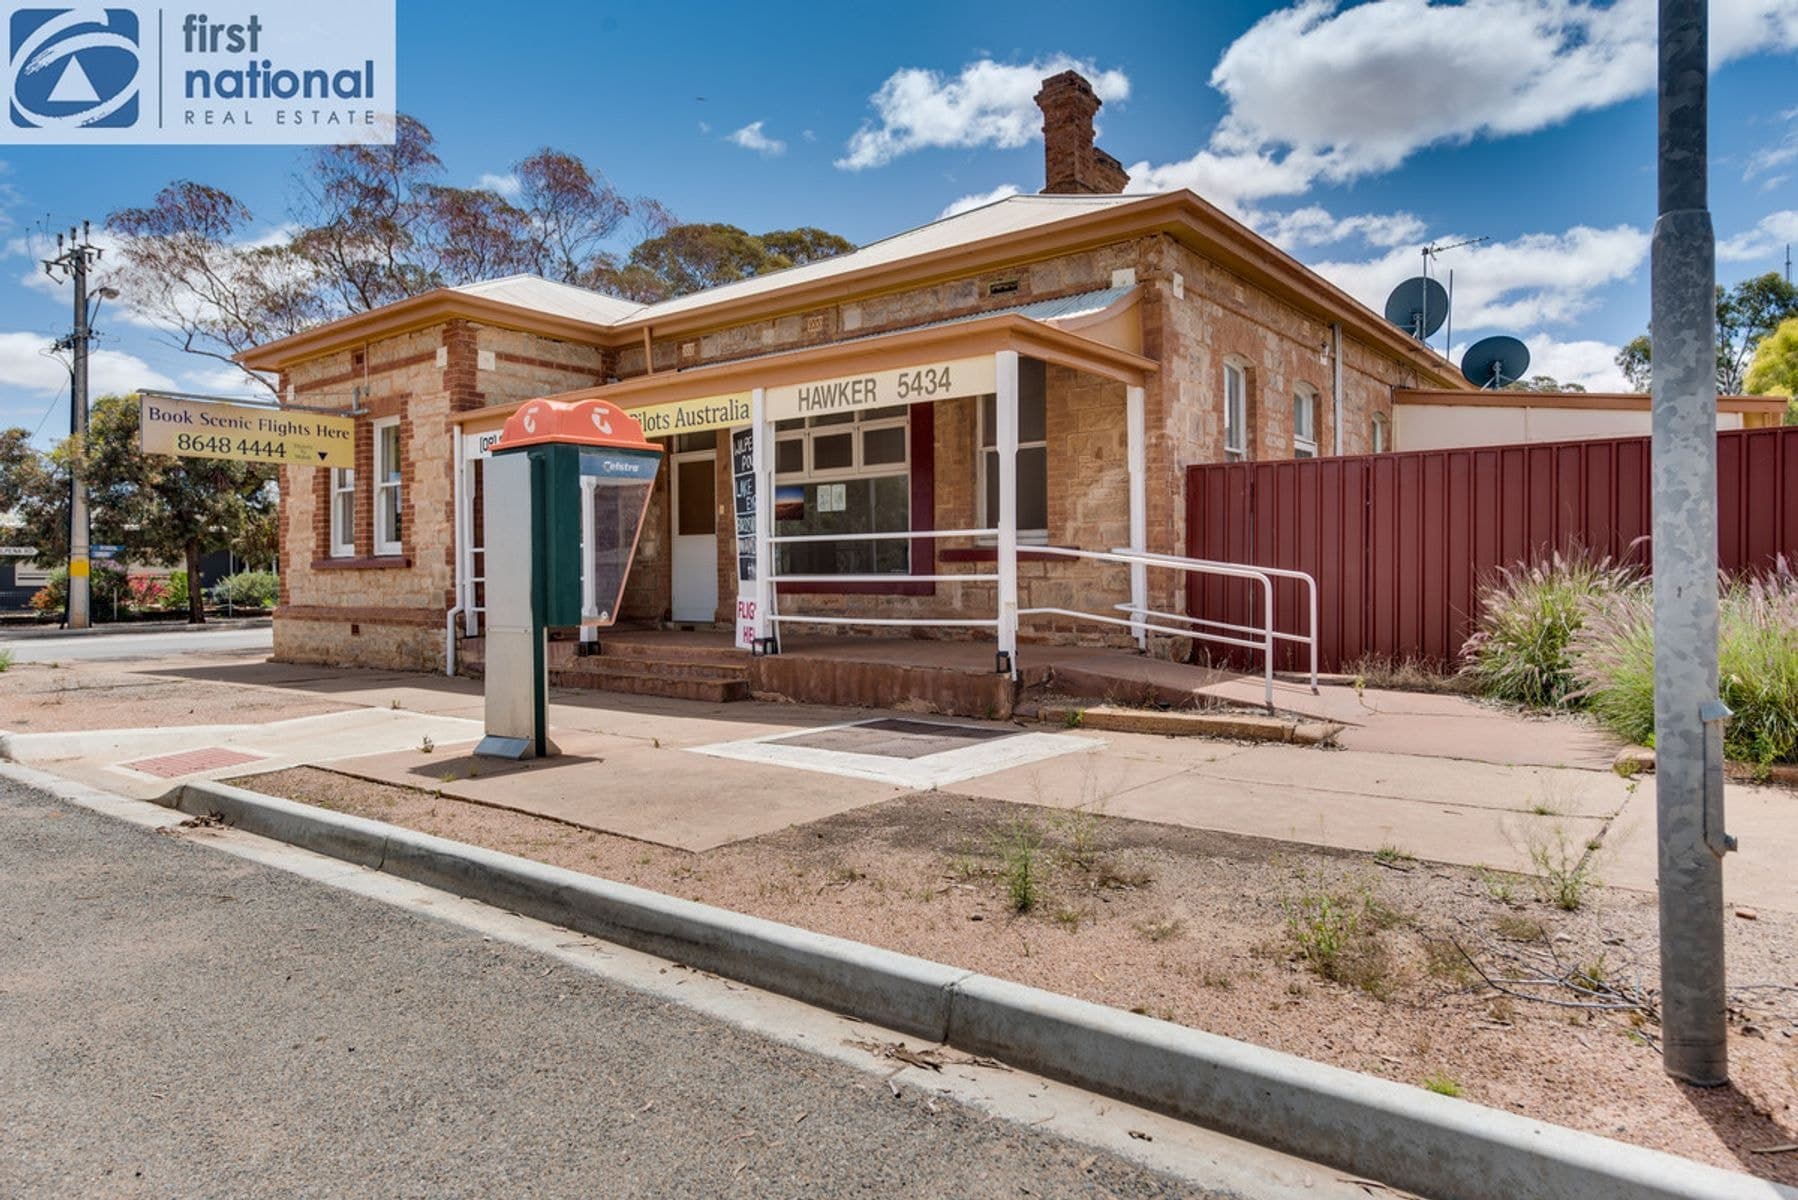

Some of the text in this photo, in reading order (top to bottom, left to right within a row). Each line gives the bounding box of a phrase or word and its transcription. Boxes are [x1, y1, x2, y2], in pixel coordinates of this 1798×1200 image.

[798, 366, 952, 412] HAWKER 5434
[149, 406, 350, 440] Book Scenic Flights Here
[630, 398, 750, 432] ilots Australia
[177, 433, 287, 458] 8648 4444
